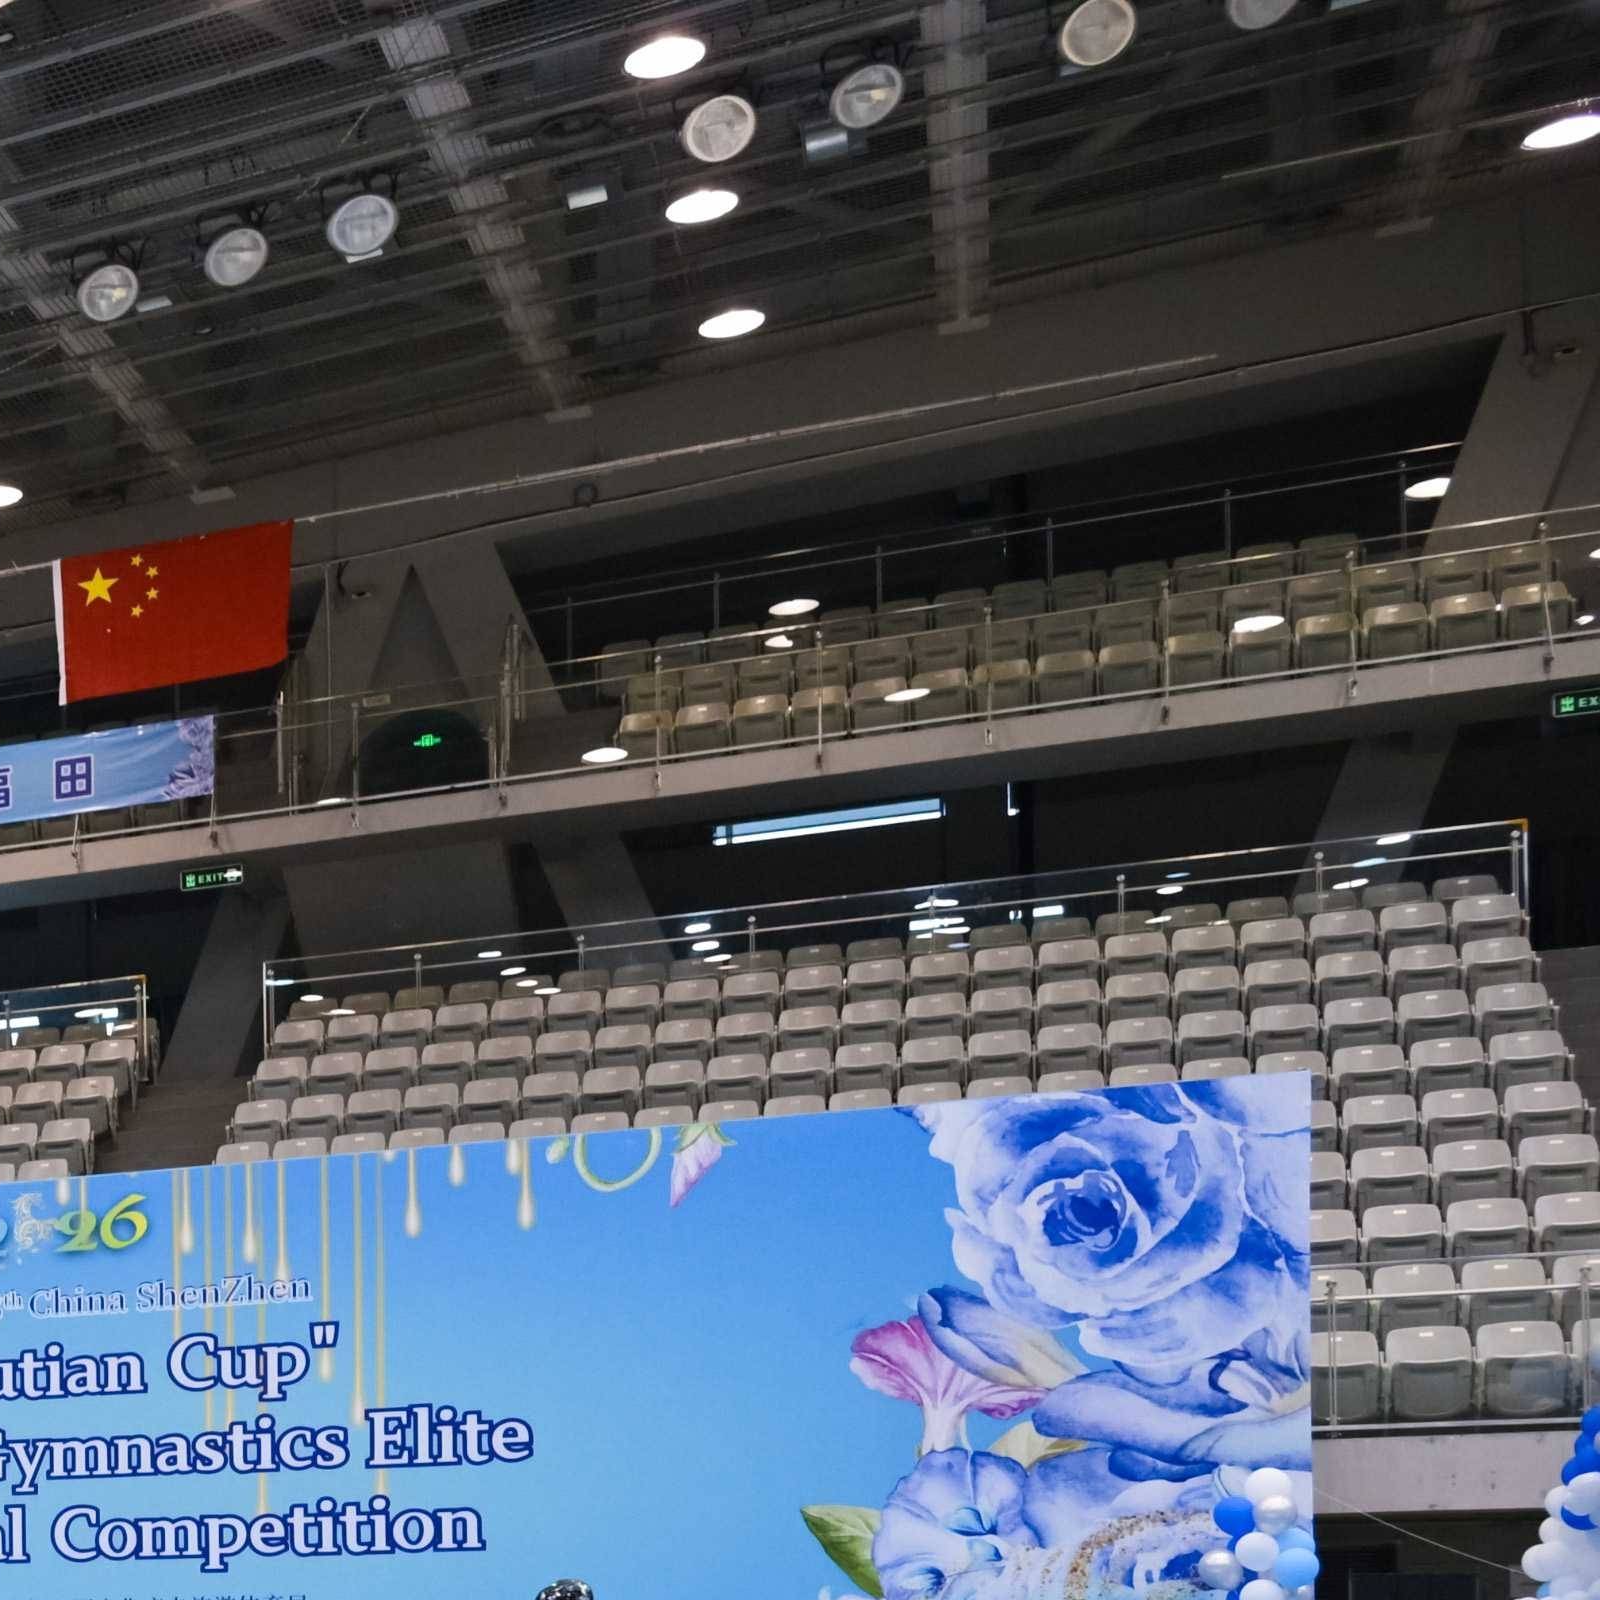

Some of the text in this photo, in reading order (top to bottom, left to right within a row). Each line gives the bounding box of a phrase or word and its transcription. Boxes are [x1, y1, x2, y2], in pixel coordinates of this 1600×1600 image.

[1578, 695, 1600, 708] EX
[198, 872, 224, 884] EXIT
[29, 1285, 128, 1320] China
[136, 1273, 314, 1312] ShenZhen
[365, 1401, 535, 1470] Elite
[50, 1497, 487, 1573] Competition
